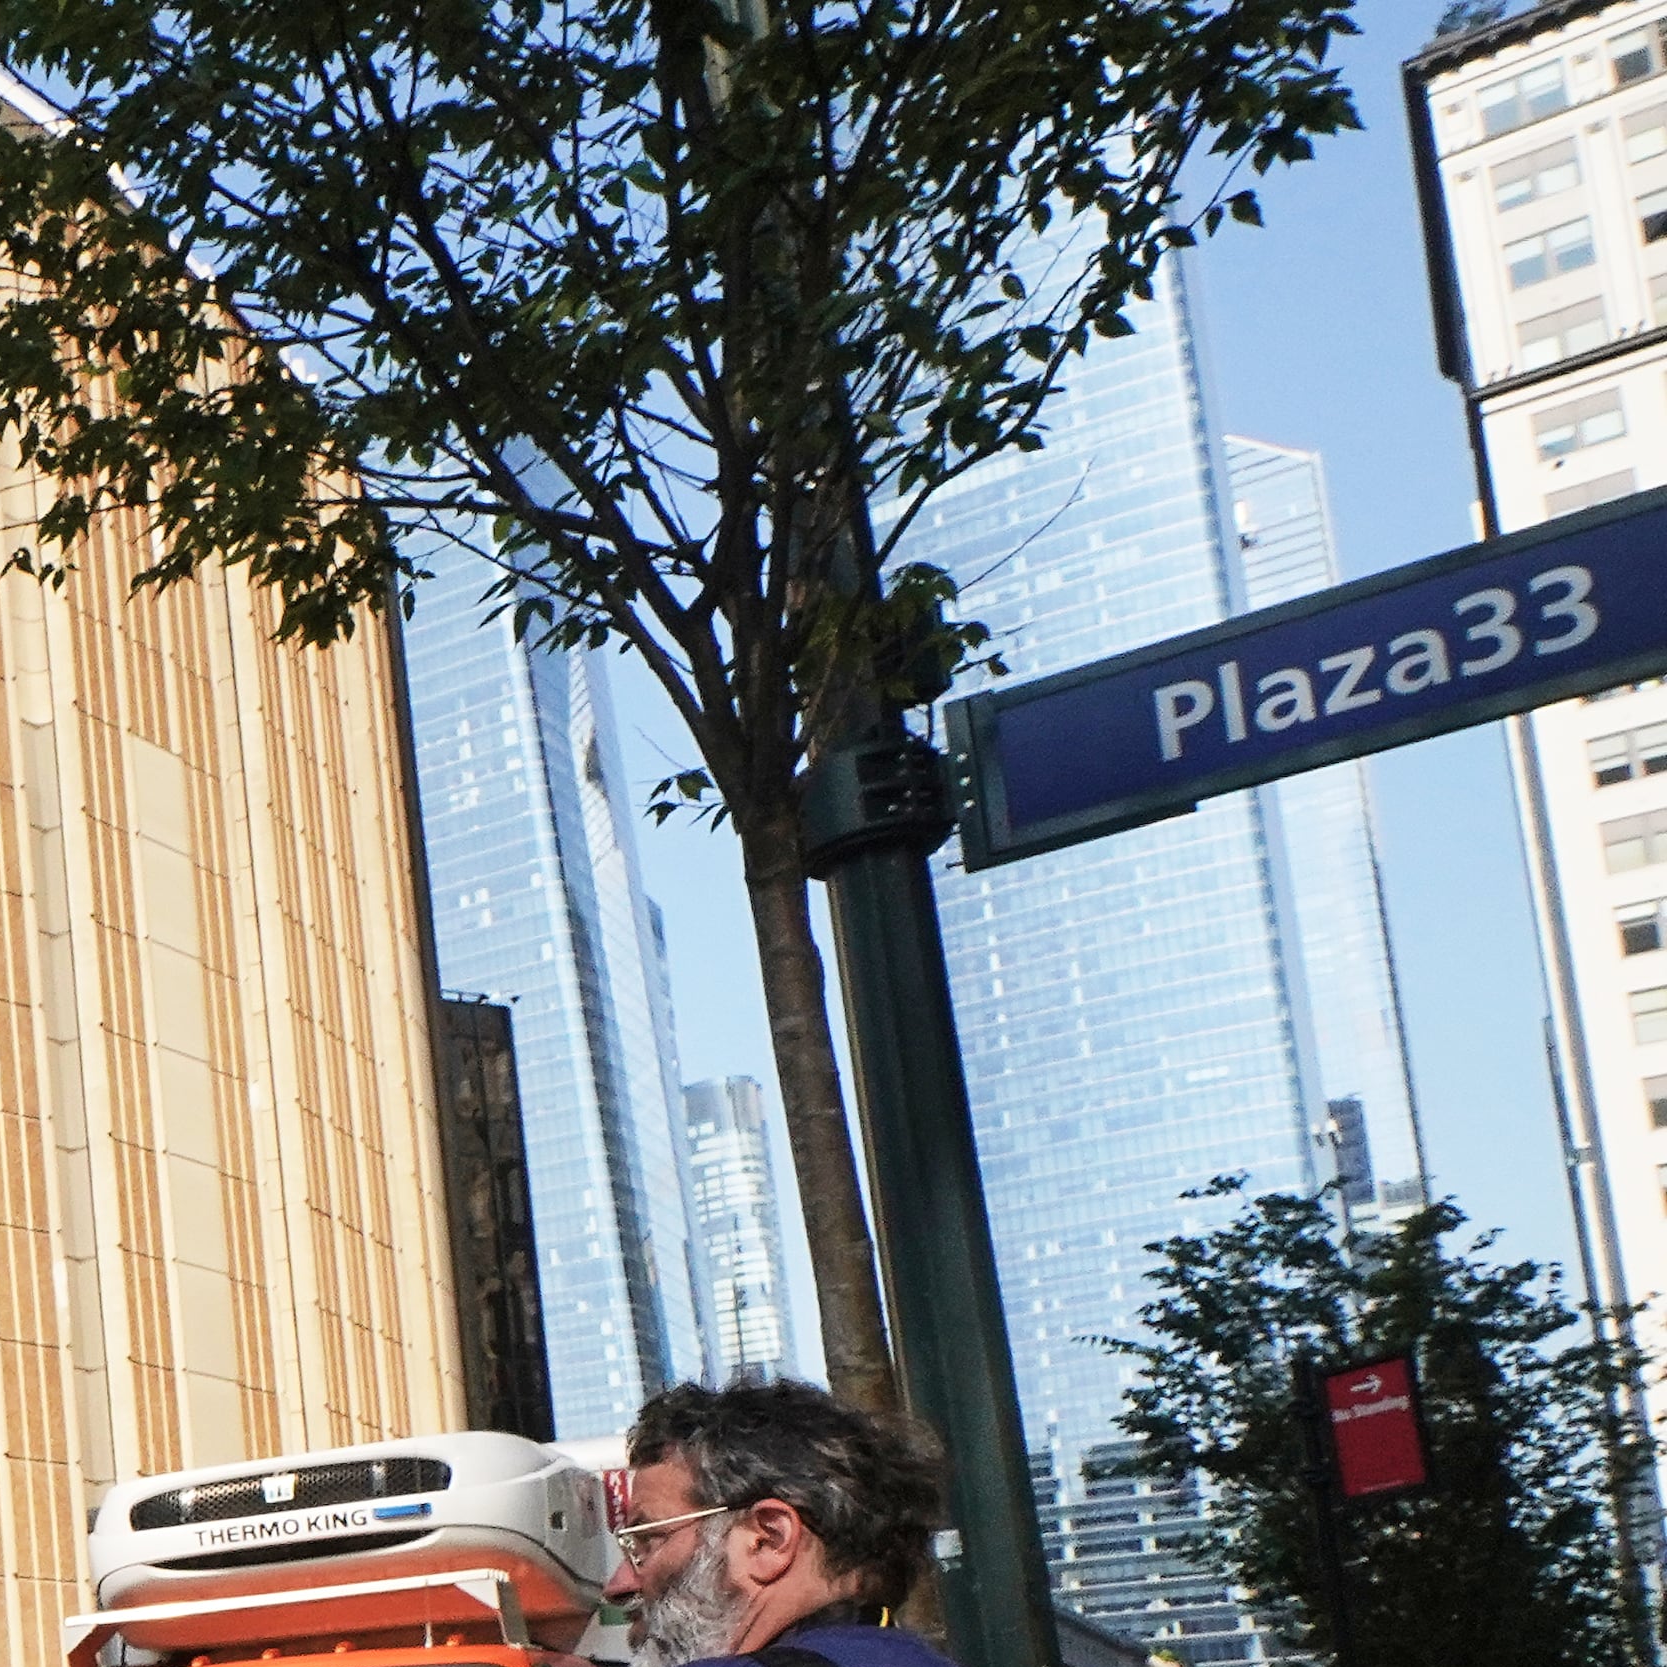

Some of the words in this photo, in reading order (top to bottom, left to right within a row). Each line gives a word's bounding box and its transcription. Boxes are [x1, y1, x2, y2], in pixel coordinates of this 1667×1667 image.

[1153, 565, 1599, 761] Plaza33
[195, 1517, 300, 1547] THERMO
[306, 1509, 368, 1534] KING
